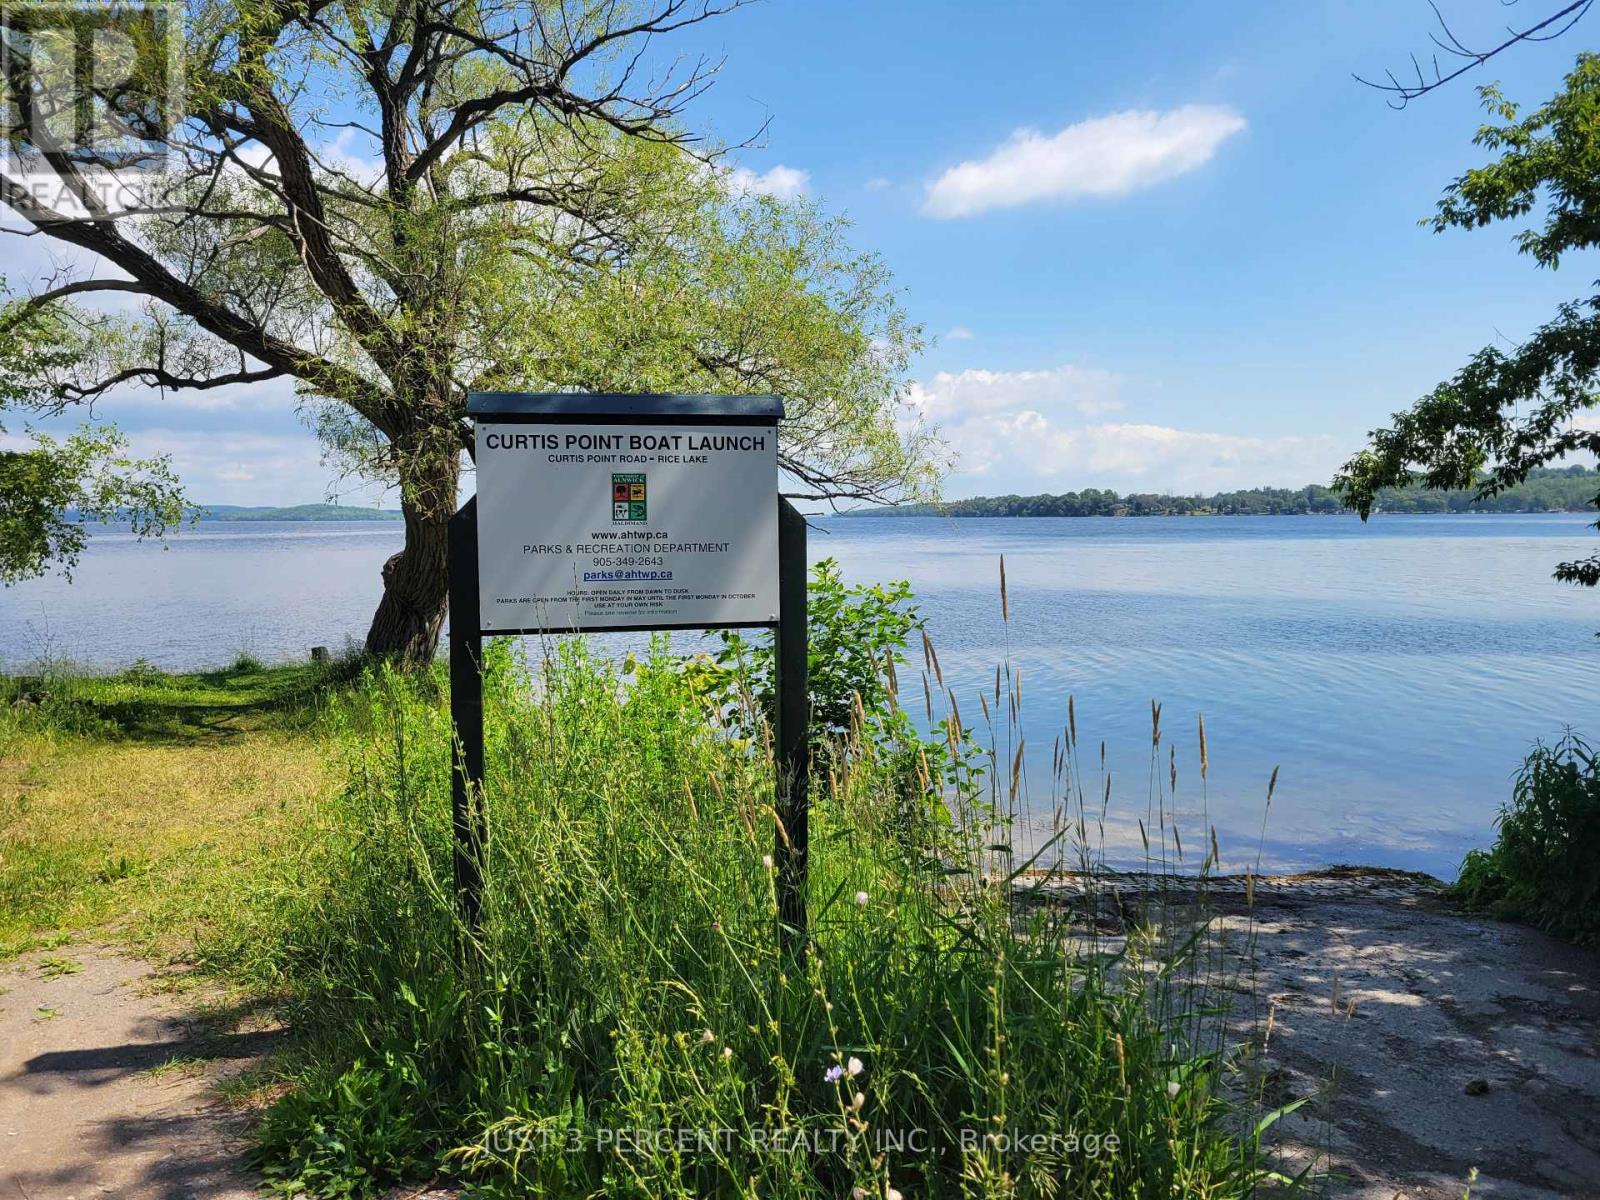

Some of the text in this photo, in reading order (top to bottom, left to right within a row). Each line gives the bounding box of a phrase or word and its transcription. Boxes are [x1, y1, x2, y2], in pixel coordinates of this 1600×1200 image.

[486, 434, 764, 450] CURTIS POINT BOAT LAUNCH
[548, 455, 584, 463] CURTIS
[592, 531, 668, 541] www.ahtwp.ca
[523, 543, 730, 554] PARKS & RECREATION DEPARTMENT
[593, 557, 663, 567] 905-349-2643
[584, 570, 673, 581] parks@ahtwp.ca
